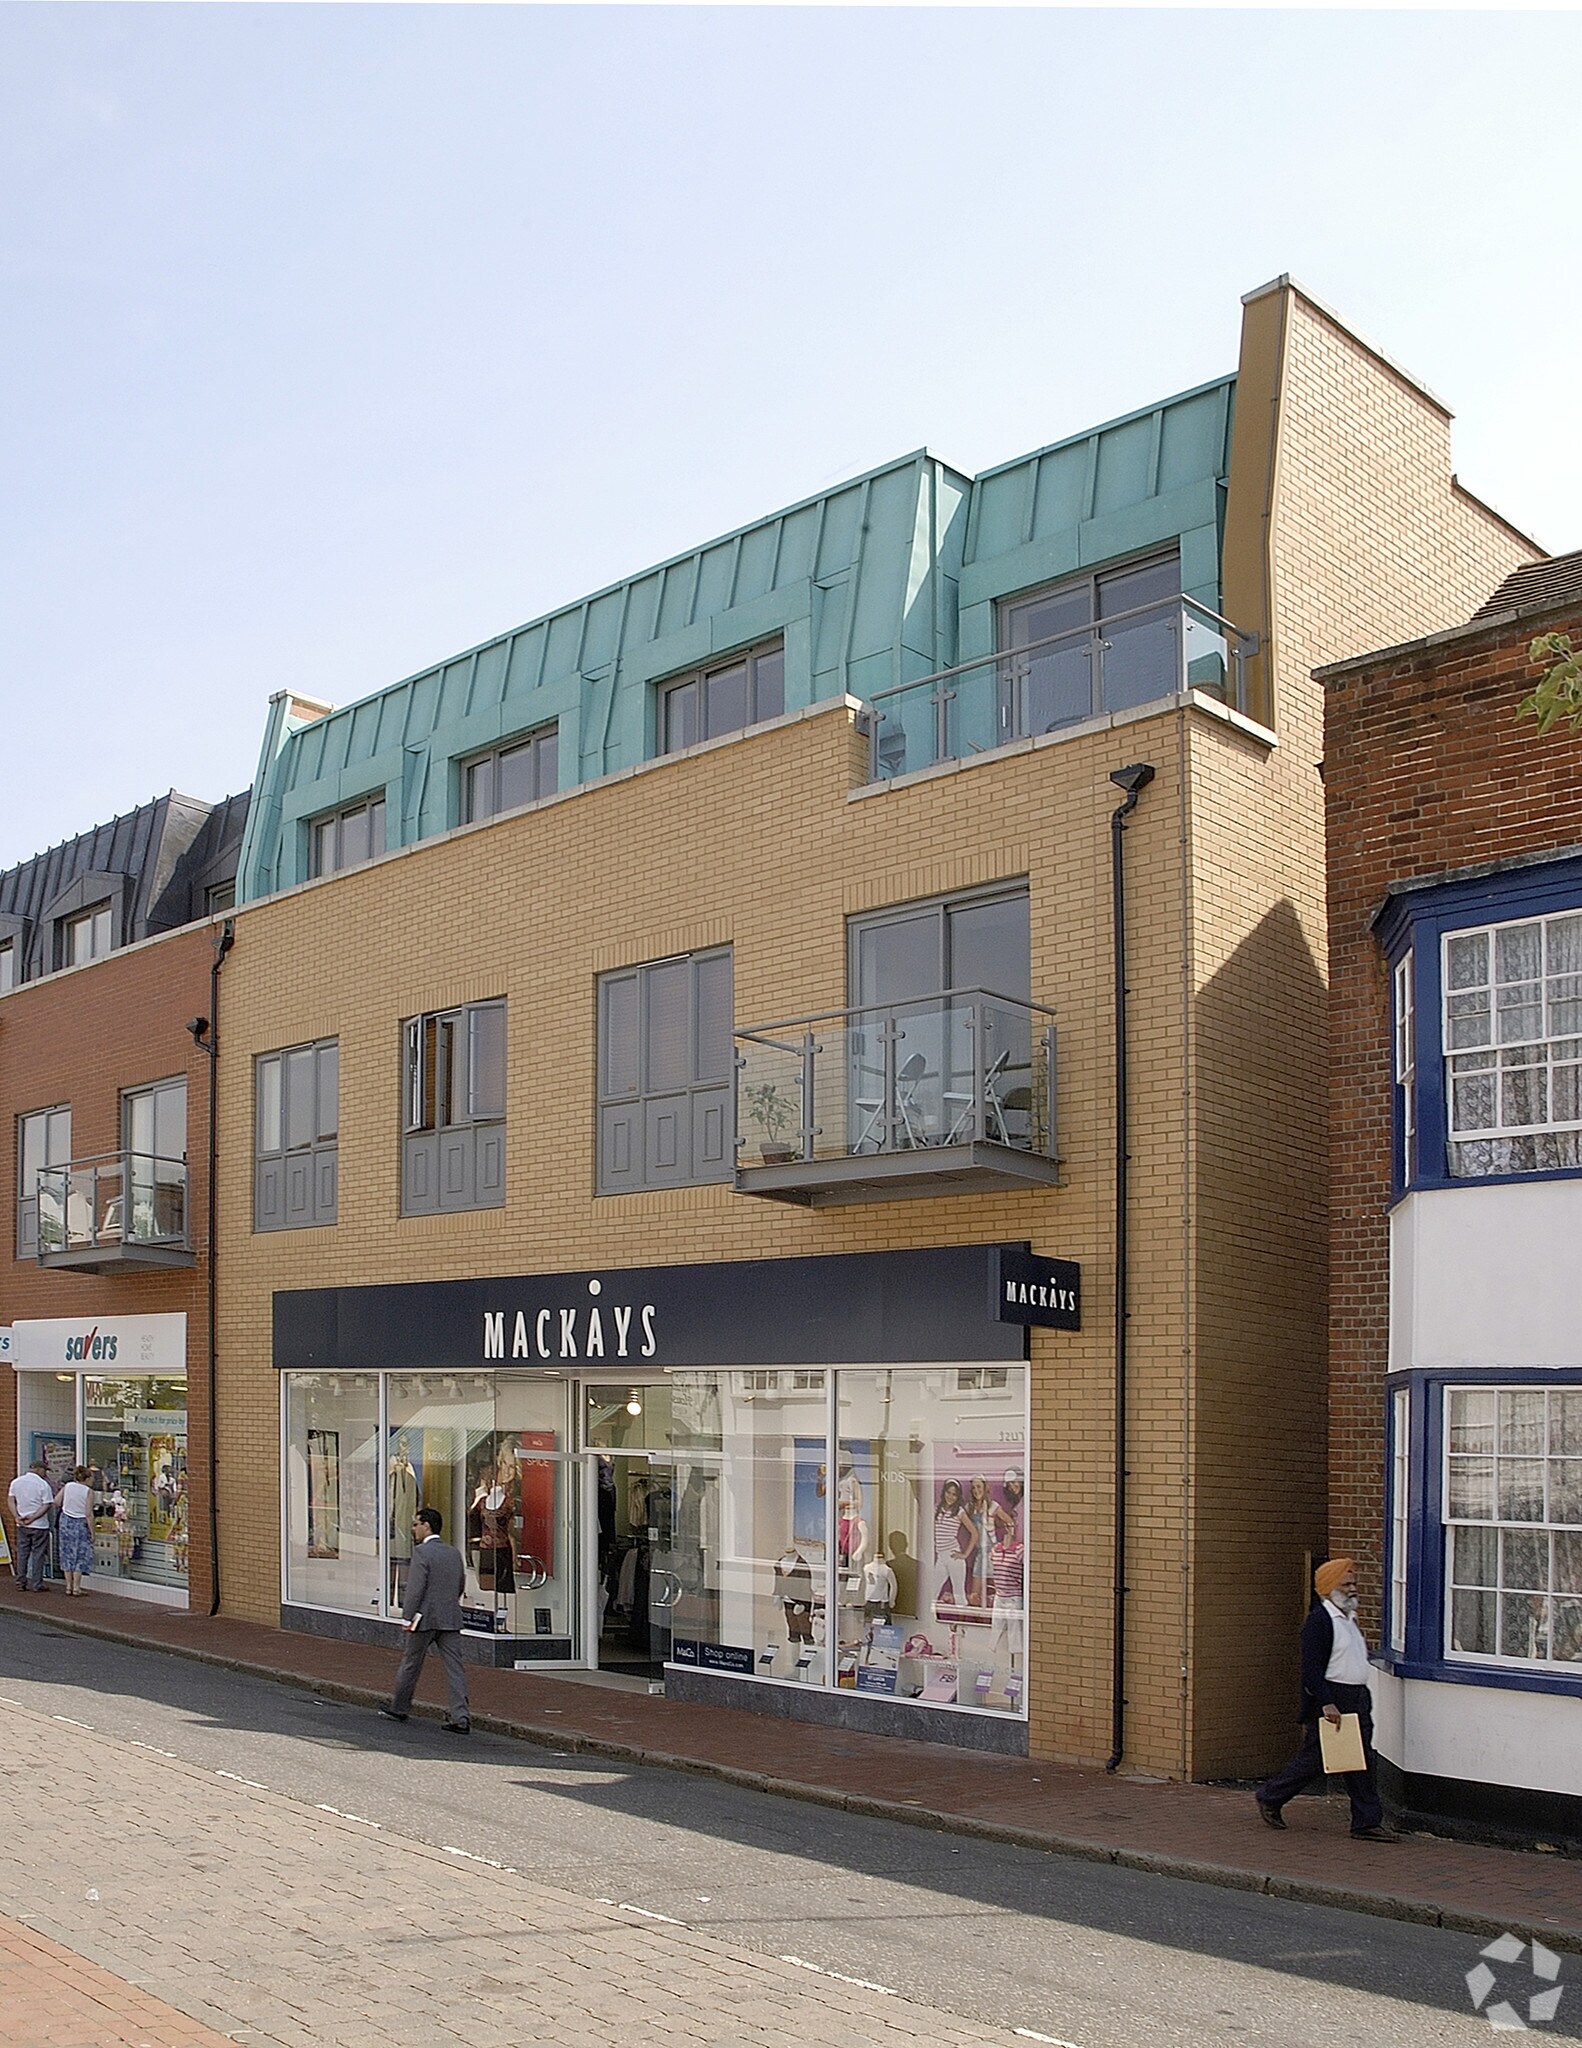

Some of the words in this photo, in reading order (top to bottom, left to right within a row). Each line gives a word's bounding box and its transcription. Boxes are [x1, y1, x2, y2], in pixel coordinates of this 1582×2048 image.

[1006, 1277, 1075, 1311] MACKAYS
[484, 1278, 657, 1359] MACKAYS
[65, 1326, 118, 1361] savers
[880, 1471, 905, 1483] KIDS
[704, 1647, 724, 1659] Shop
[725, 1651, 749, 1662] online
